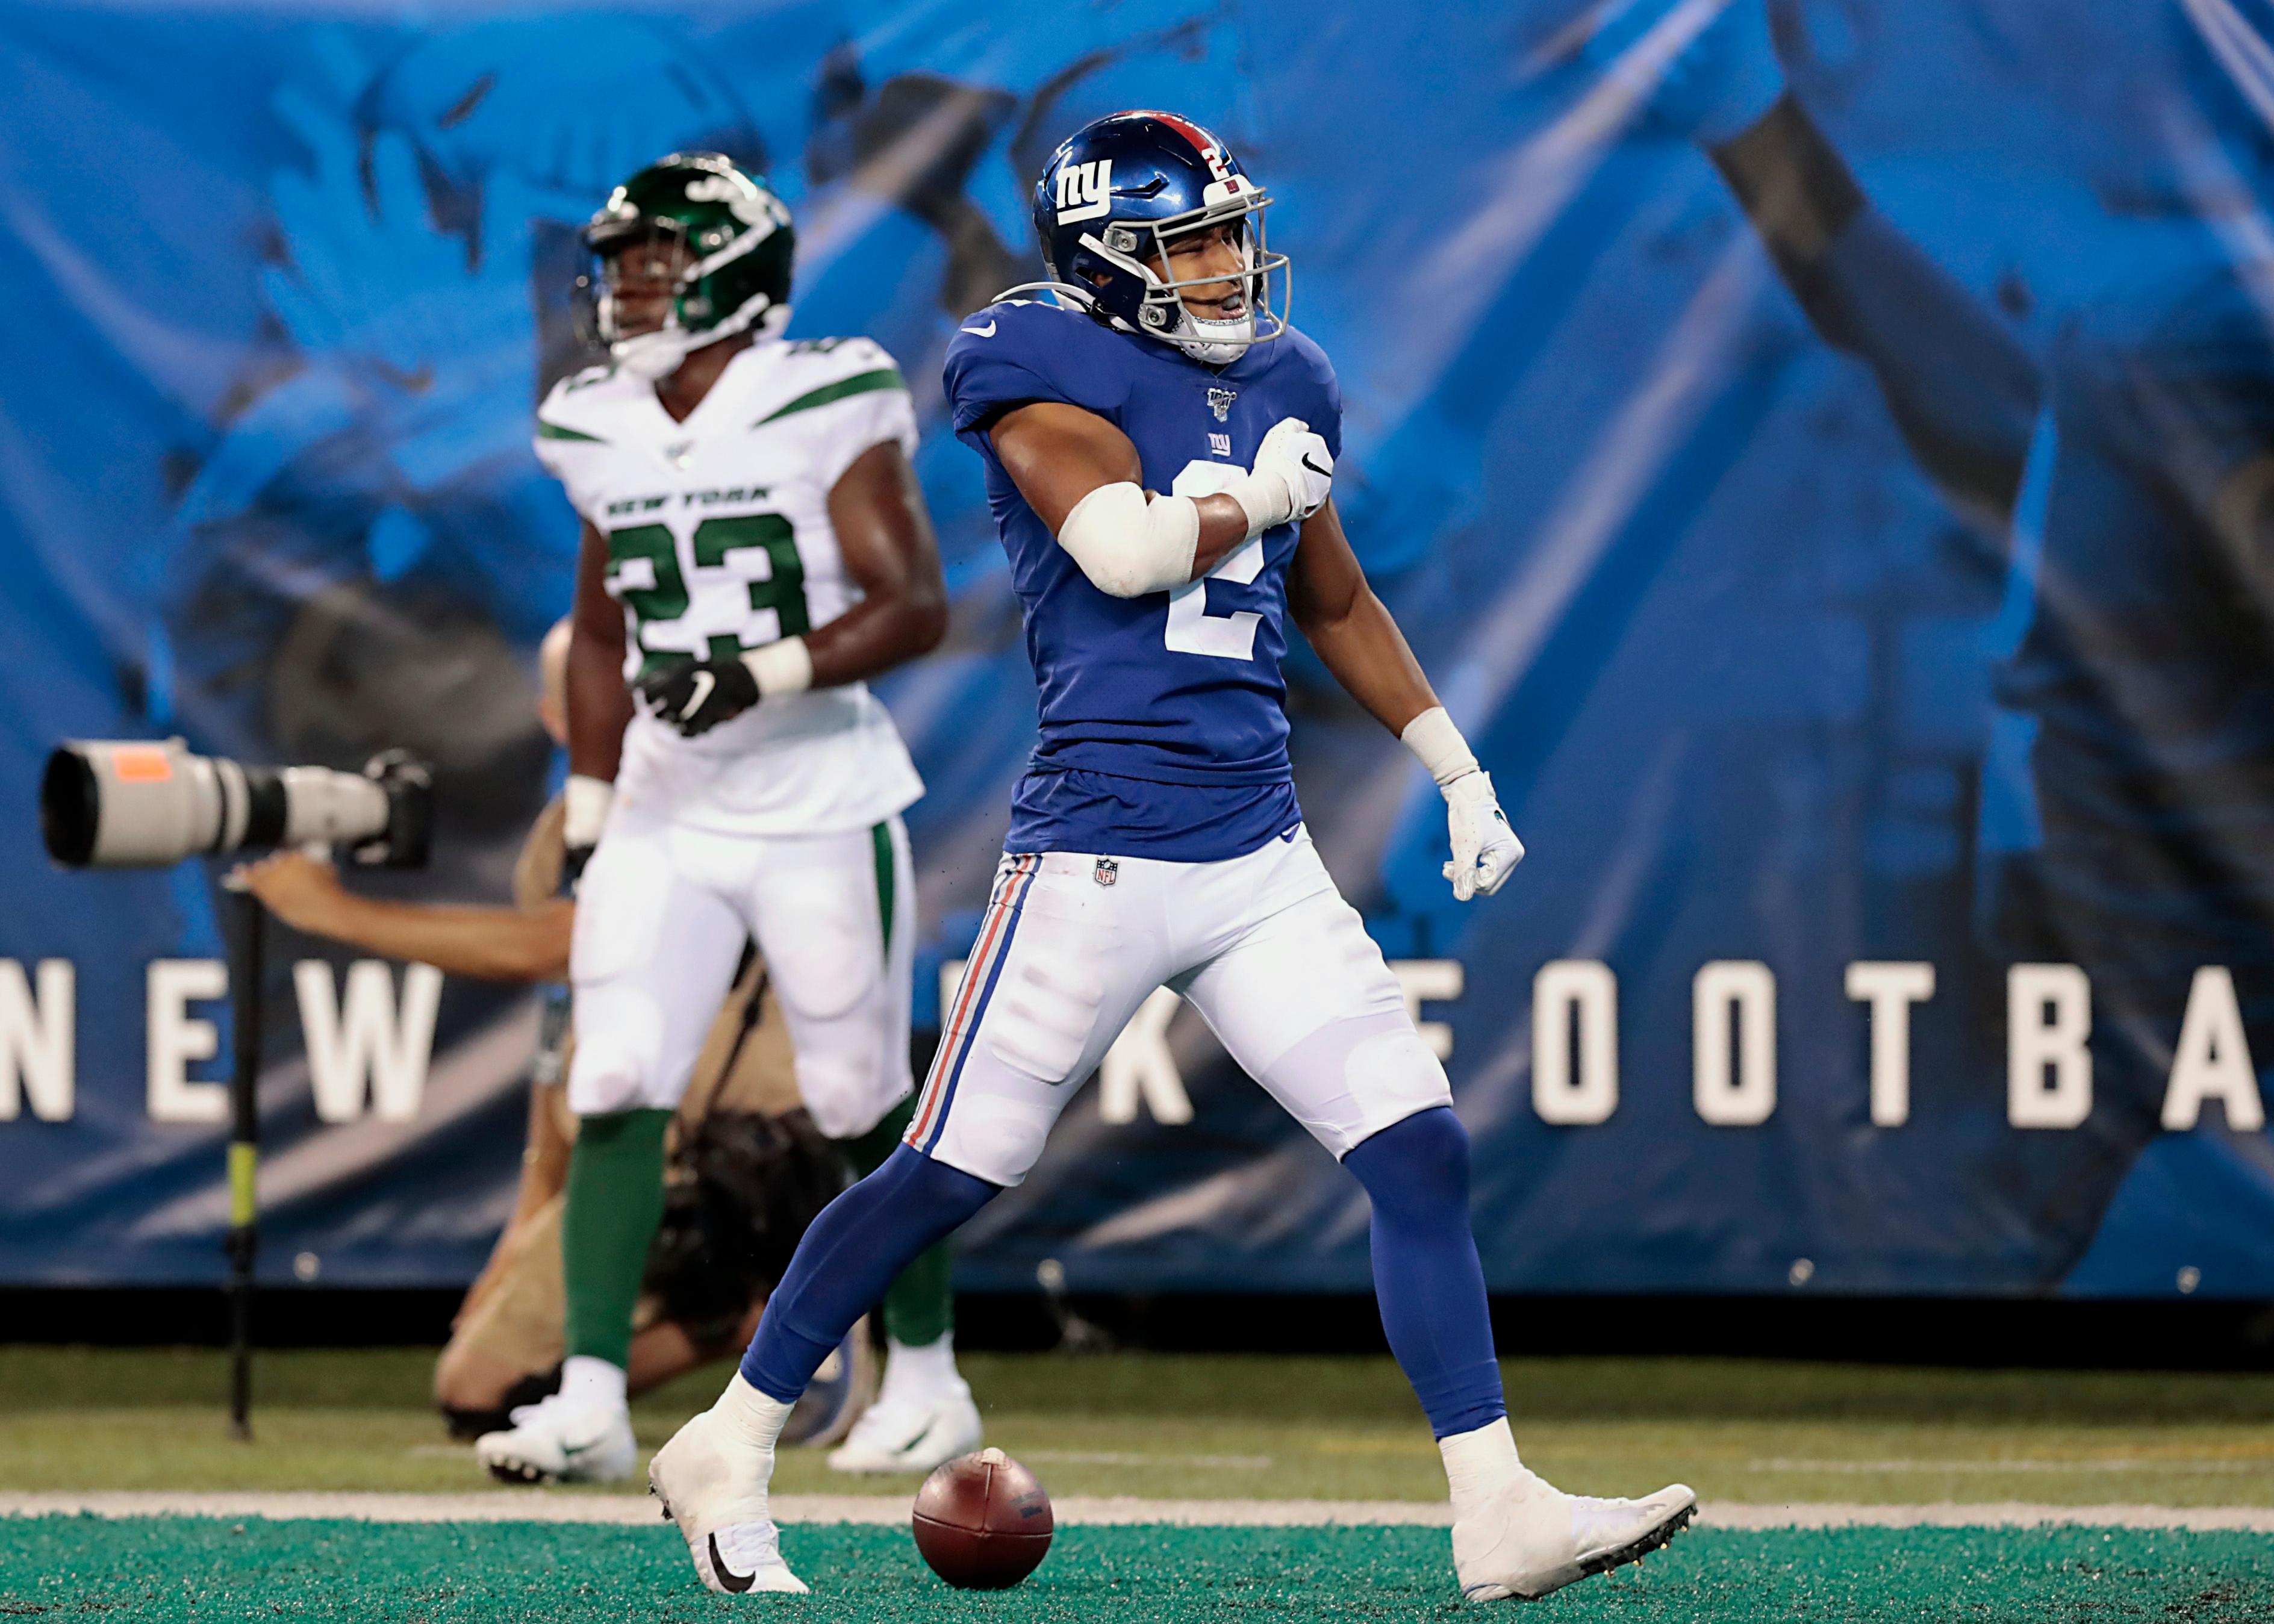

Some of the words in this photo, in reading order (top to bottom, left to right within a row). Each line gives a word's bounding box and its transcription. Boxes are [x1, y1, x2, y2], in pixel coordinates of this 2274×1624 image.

[1201, 148, 1230, 181] 2
[606, 496, 668, 517] NEW
[682, 486, 773, 507] YORK
[605, 513, 811, 679] 23
[1165, 459, 1265, 662] 2
[1097, 869, 1114, 883] NFL
[0, 957, 444, 1124] NEW
